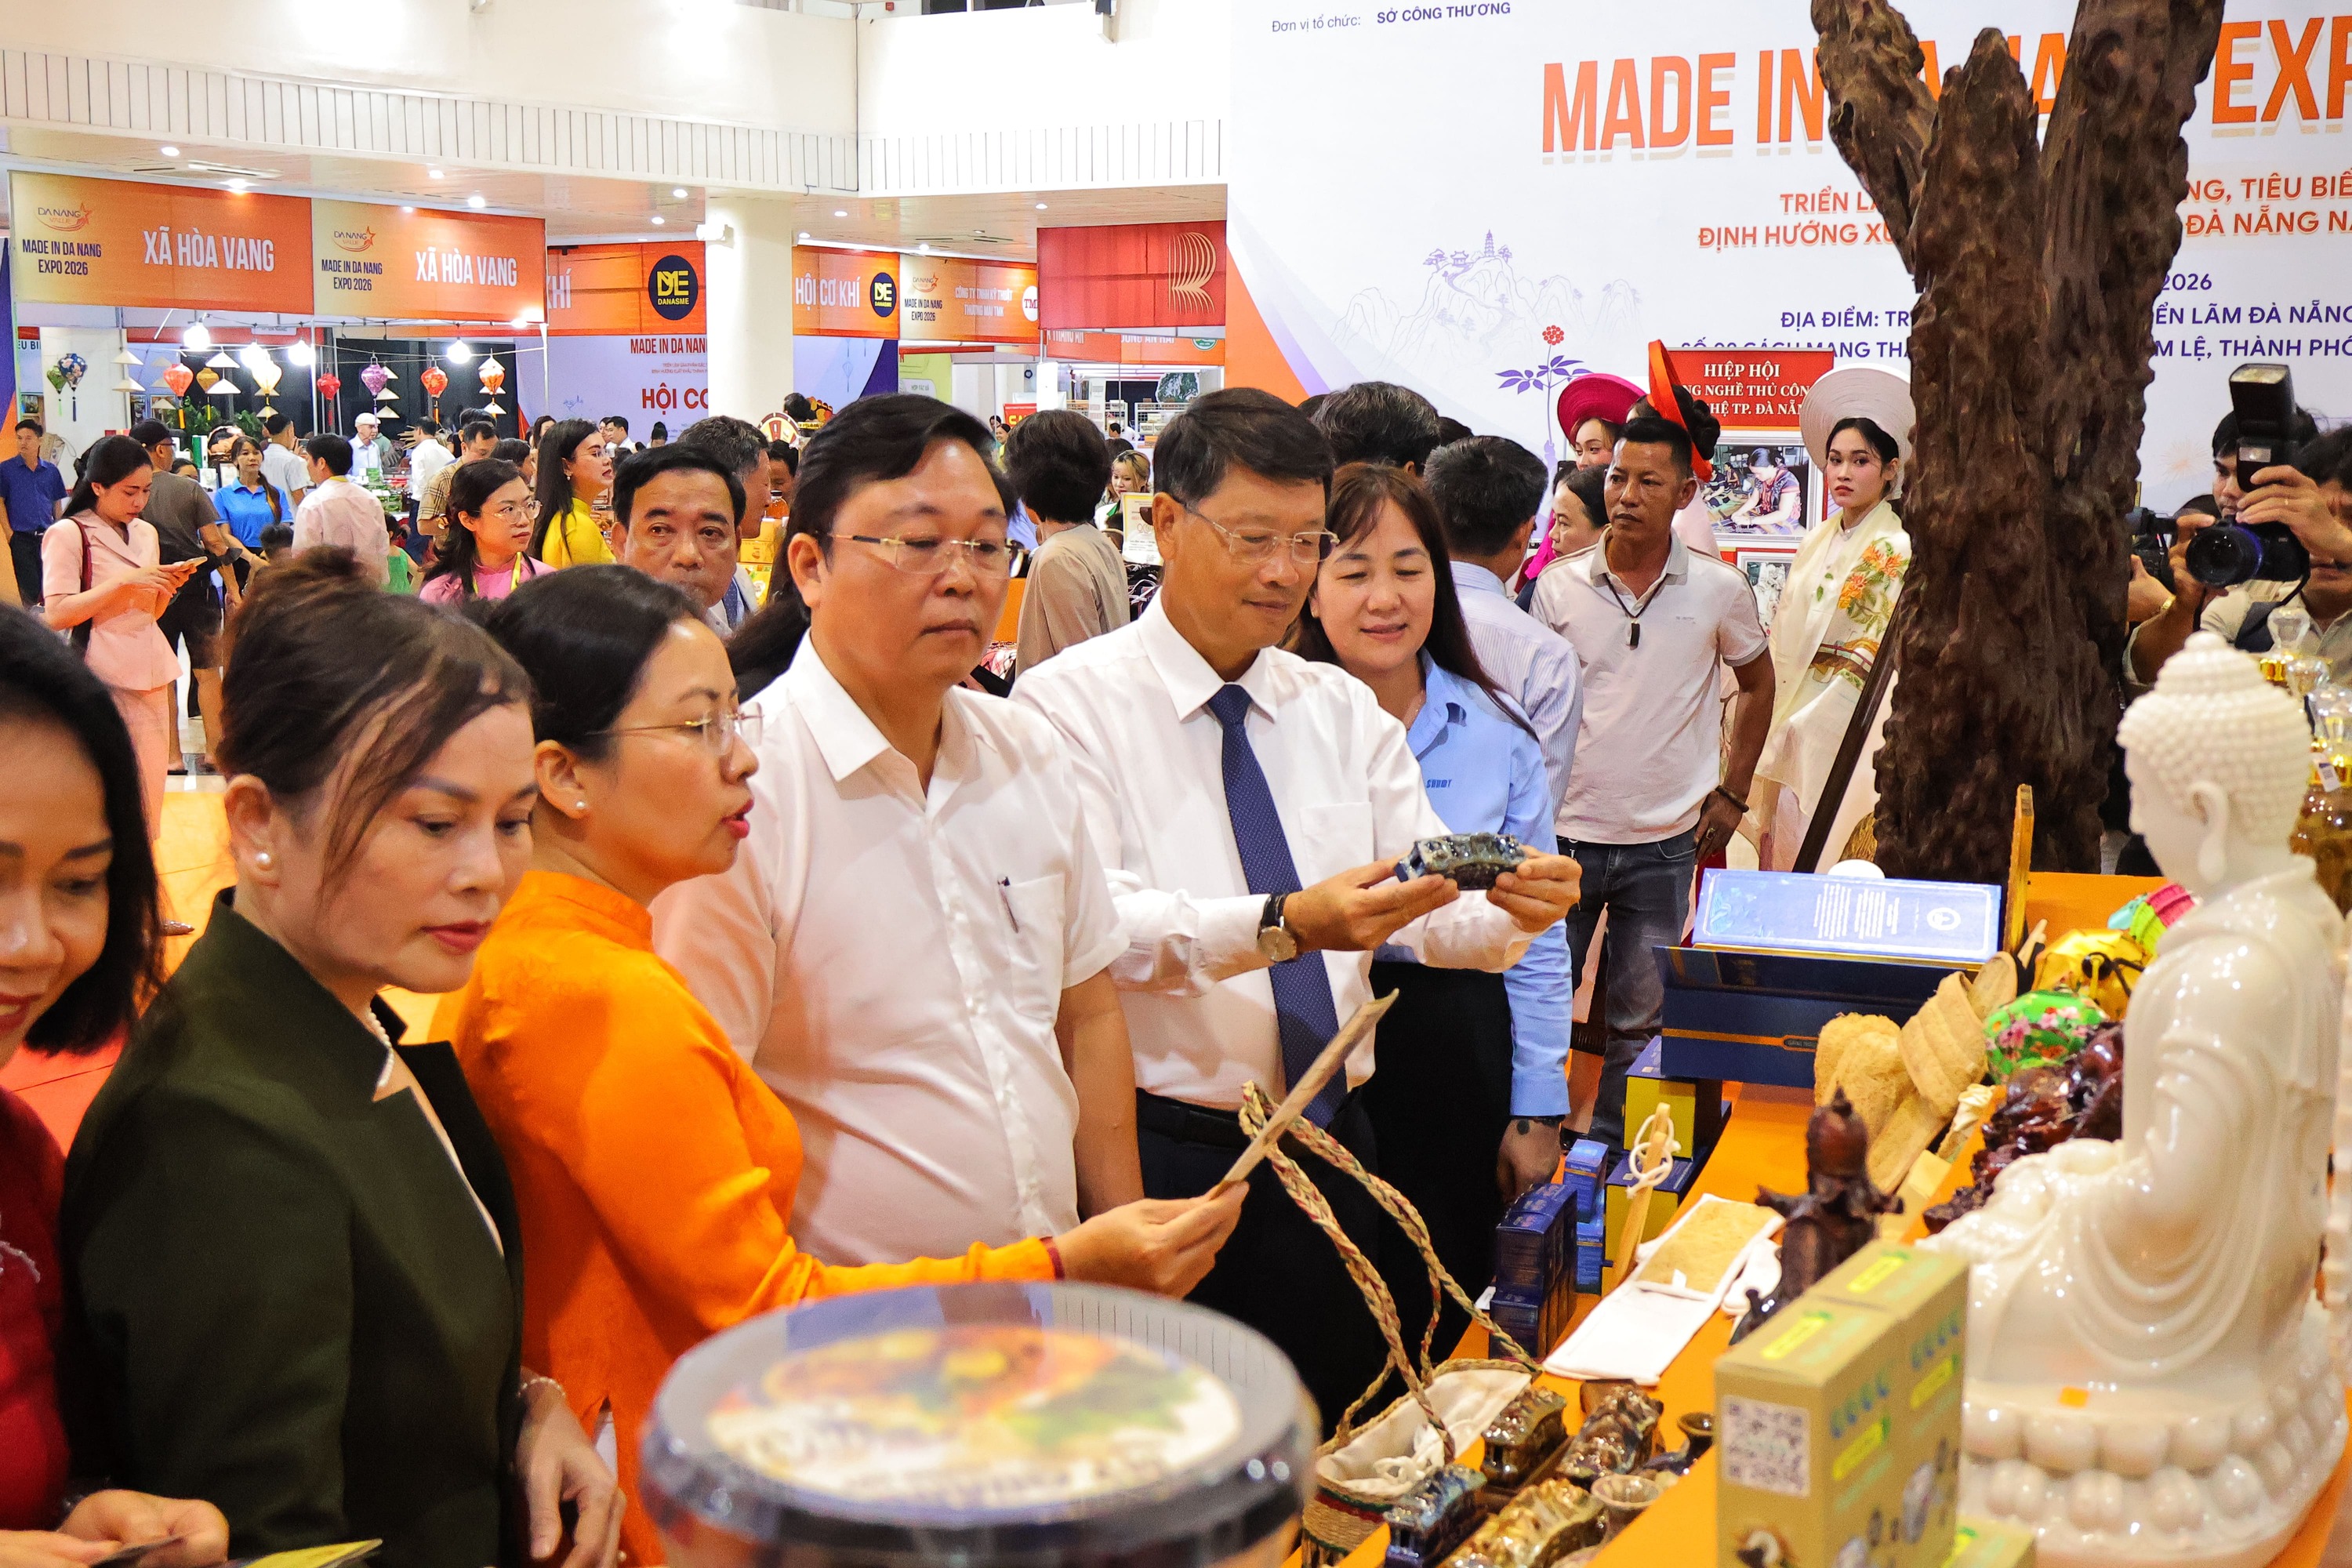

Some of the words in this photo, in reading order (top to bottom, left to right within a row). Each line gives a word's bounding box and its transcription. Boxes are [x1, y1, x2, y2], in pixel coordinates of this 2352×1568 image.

[1377, 8, 1398, 24] SỞ
[1402, 5, 1443, 22] CÔNG
[1446, 2, 1511, 18] THƯƠNG
[1272, 20, 1297, 32] Đơn
[1300, 18, 1309, 32] vị
[1312, 14, 1324, 29] tổ
[1327, 14, 1361, 28] chức:
[1543, 53, 1736, 152] MADE
[1757, 47, 1826, 143] IN
[1780, 185, 1849, 213] TRIỂN
[2241, 172, 2302, 198] TIÊU
[1698, 226, 1757, 251] ĐỊNH
[1766, 220, 1859, 245] HƯỚNG
[1865, 222, 1893, 244] XU
[2186, 209, 2225, 235] ĐÀ
[2234, 205, 2320, 233] NẴNG
[2328, 211, 2352, 231] N
[22, 239, 49, 254] MADE
[51, 241, 60, 255] IN
[63, 241, 75, 256] DA
[77, 243, 102, 257] NANG
[143, 226, 173, 265] XÃ
[177, 227, 219, 268] HÒA
[222, 236, 274, 272] VANG
[38, 260, 63, 274] EXPO
[64, 261, 89, 275] 2026
[321, 259, 342, 273] MADE
[343, 260, 351, 273] IN
[352, 261, 362, 274] DA
[363, 263, 383, 275] NANG
[415, 246, 438, 282] XÃ
[441, 248, 474, 285] HÒA
[477, 256, 517, 287] VANG
[333, 277, 352, 290] EXPO
[354, 278, 372, 291] 2026
[795, 272, 817, 310] HỘI
[819, 278, 837, 307] CƠ
[838, 276, 861, 307] KHÍ
[904, 298, 917, 308] MADE
[917, 299, 924, 308] IN
[924, 299, 930, 309] DA
[931, 299, 942, 310] NANG
[1024, 299, 1038, 309] TM
[911, 310, 924, 321] EXPO
[924, 311, 936, 321] 2026
[1781, 311, 1816, 332] ĐỊA
[1822, 306, 1879, 328] ĐIỂM:
[1885, 311, 1911, 327] TR
[2156, 302, 2184, 324] ỂN
[2192, 303, 2241, 324] LÃM
[2249, 303, 2281, 324] ĐÀ
[630, 338, 657, 354] MADE
[659, 338, 669, 354] IN
[671, 338, 684, 354] DA
[686, 337, 708, 354] NAN
[2155, 340, 2173, 357] M
[2181, 336, 2212, 361] LỆ,
[2220, 336, 2302, 357] THÀNH
[1704, 360, 1745, 380] HIỆP
[1749, 360, 1780, 380] HỘI
[641, 382, 677, 416] HỘI
[1704, 382, 1744, 397] NGHỀ
[1747, 382, 1777, 397] THỦ
[1780, 382, 1811, 397] CÔN
[1708, 401, 1729, 417] HỆ
[1732, 403, 1752, 415] TP.
[1755, 401, 1774, 415] ĐÀ
